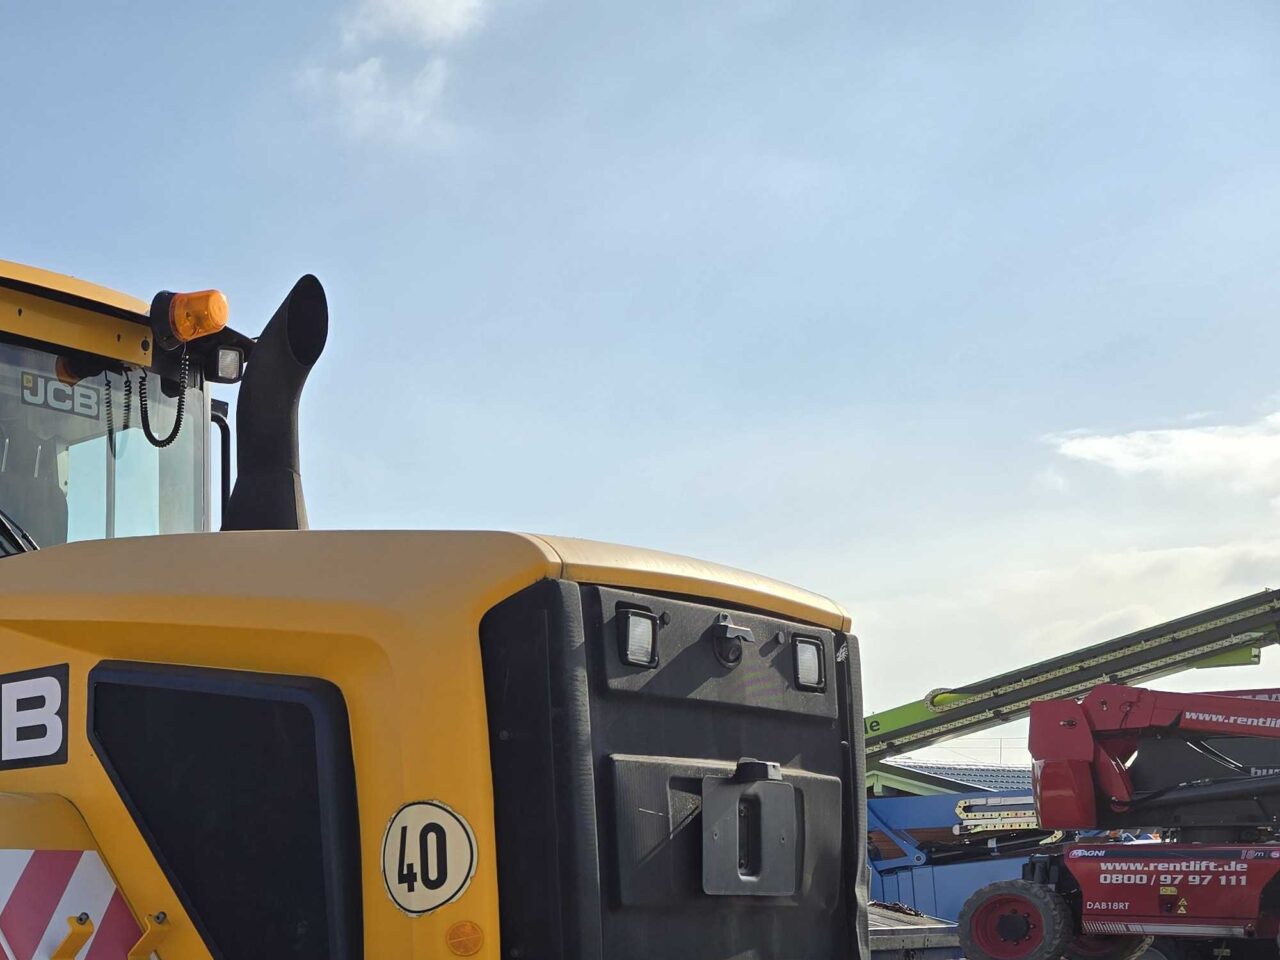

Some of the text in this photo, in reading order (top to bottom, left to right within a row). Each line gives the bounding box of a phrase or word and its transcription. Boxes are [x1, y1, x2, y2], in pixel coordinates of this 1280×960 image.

[23, 376, 98, 417] JCB
[397, 821, 448, 893] 40
[1070, 849, 1106, 858] MAGNI
[1100, 860, 1248, 872] www.rentlift.de
[1099, 873, 1147, 885] 0800
[1159, 874, 1184, 886] 97
[1188, 874, 1213, 886] 97
[1219, 875, 1247, 886] 111
[1086, 901, 1130, 911] DAB18RT
